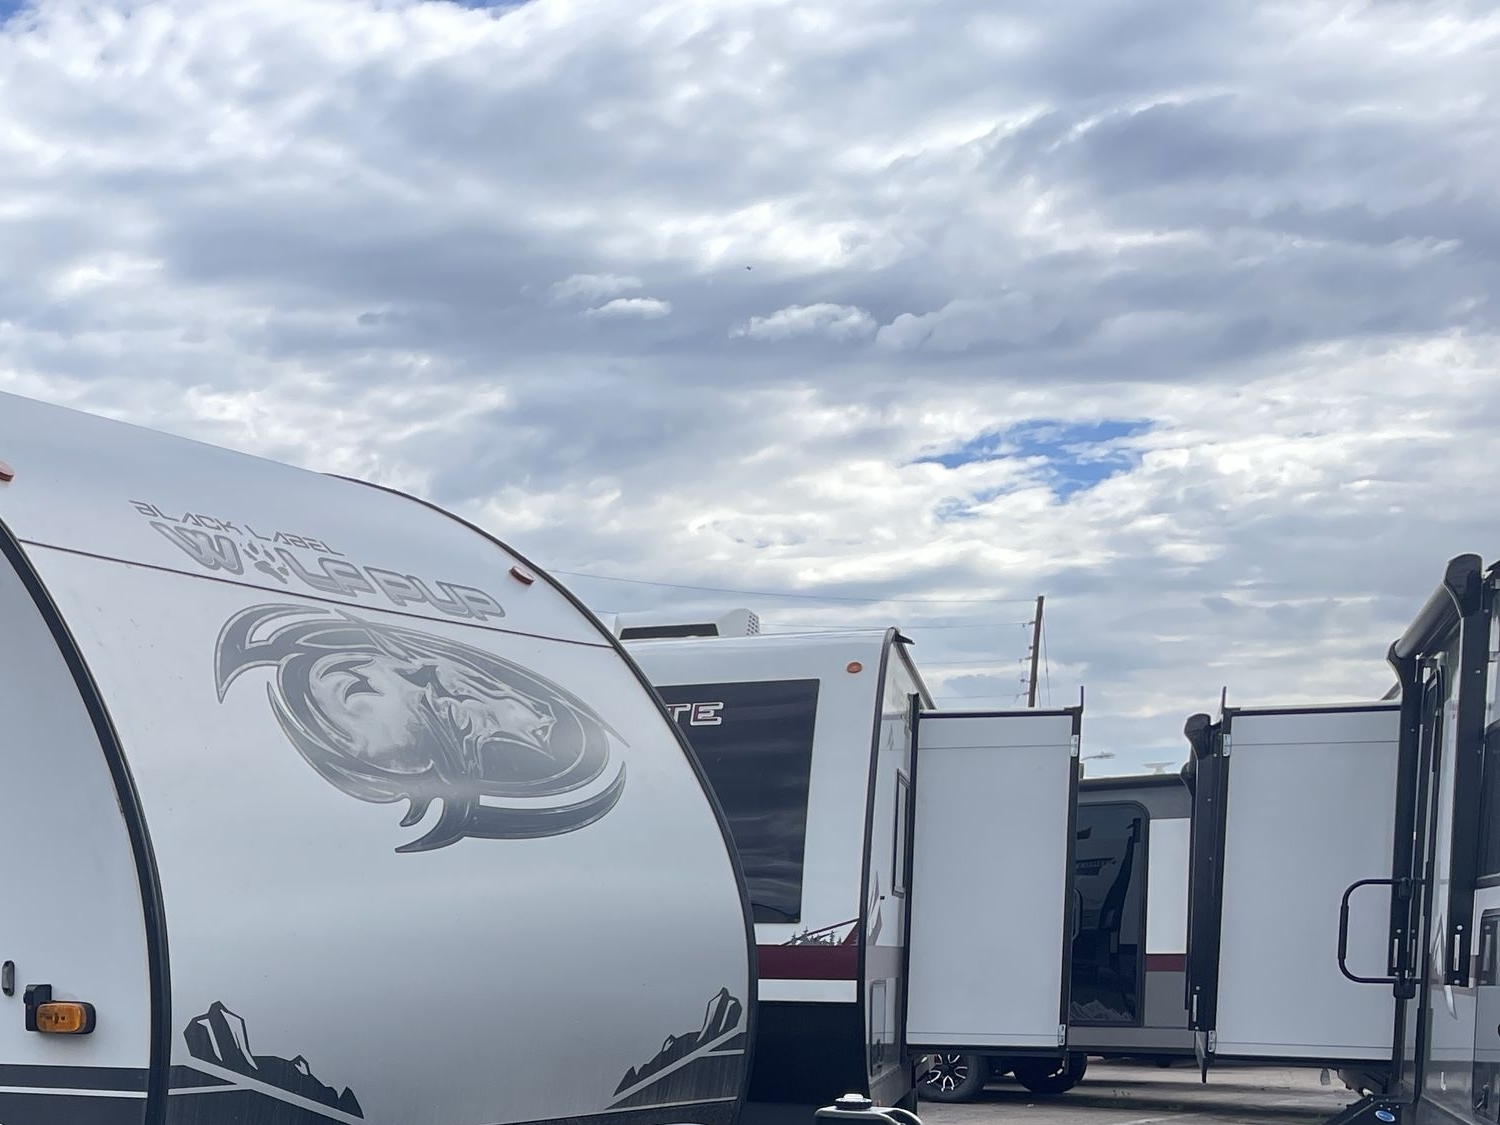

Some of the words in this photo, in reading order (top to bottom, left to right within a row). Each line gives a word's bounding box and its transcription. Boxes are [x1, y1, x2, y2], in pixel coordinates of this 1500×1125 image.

[129, 500, 243, 536] BLACK
[244, 524, 345, 557] LABEL
[363, 565, 506, 621] PUP
